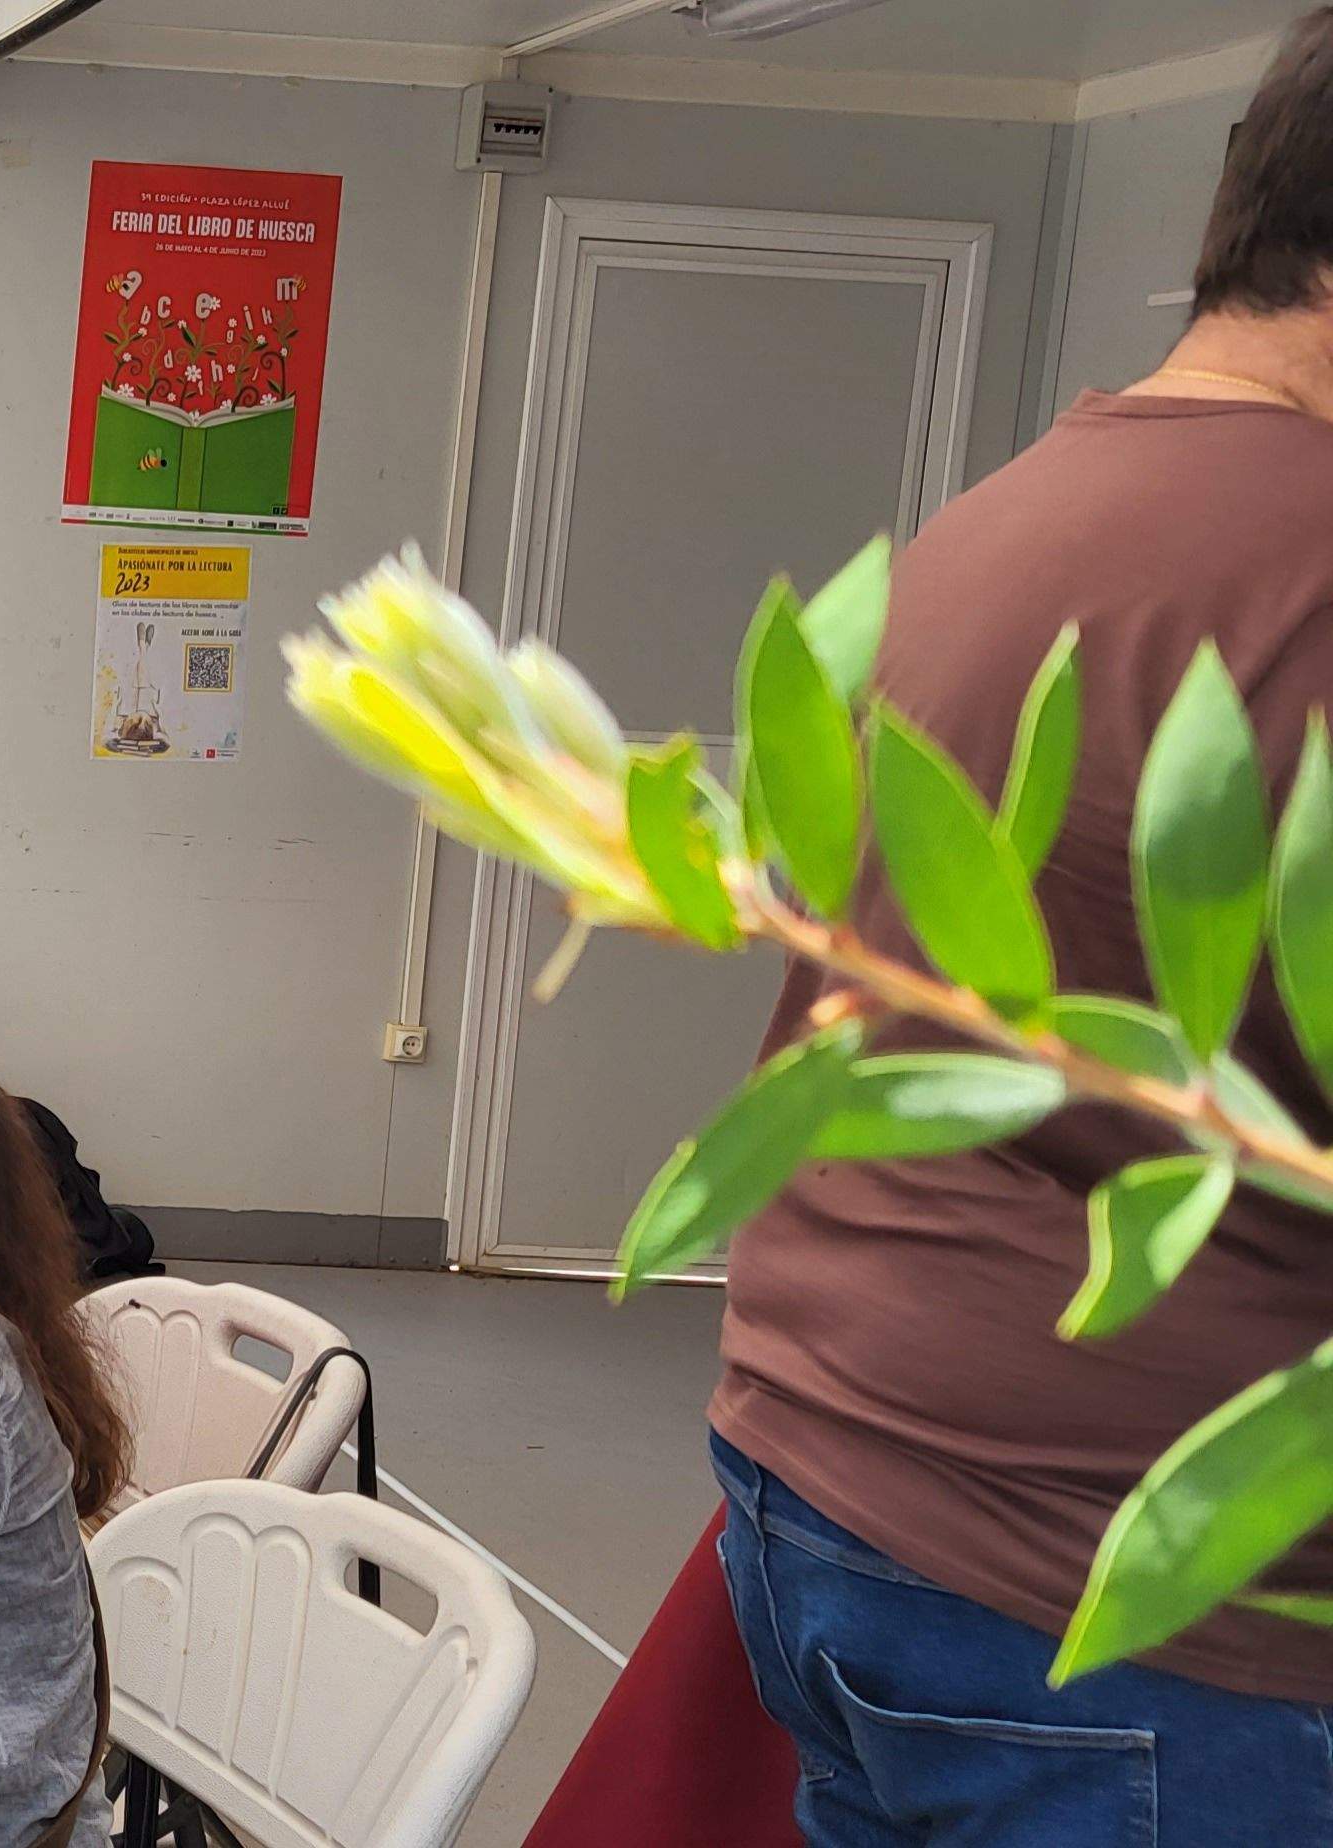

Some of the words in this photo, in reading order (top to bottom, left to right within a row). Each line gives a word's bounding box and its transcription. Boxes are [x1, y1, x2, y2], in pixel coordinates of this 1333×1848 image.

[200, 196, 230, 206] PLAZA
[113, 211, 153, 233] FERIA
[157, 213, 183, 235] DEL
[188, 215, 231, 238] LIBRO
[236, 218, 255, 240] DE
[258, 220, 315, 243] HUESCA
[211, 360, 224, 382] h
[168, 560, 184, 571] POR
[188, 561, 197, 571] LA
[199, 560, 232, 572] LECTURA
[115, 572, 150, 595] 2023
